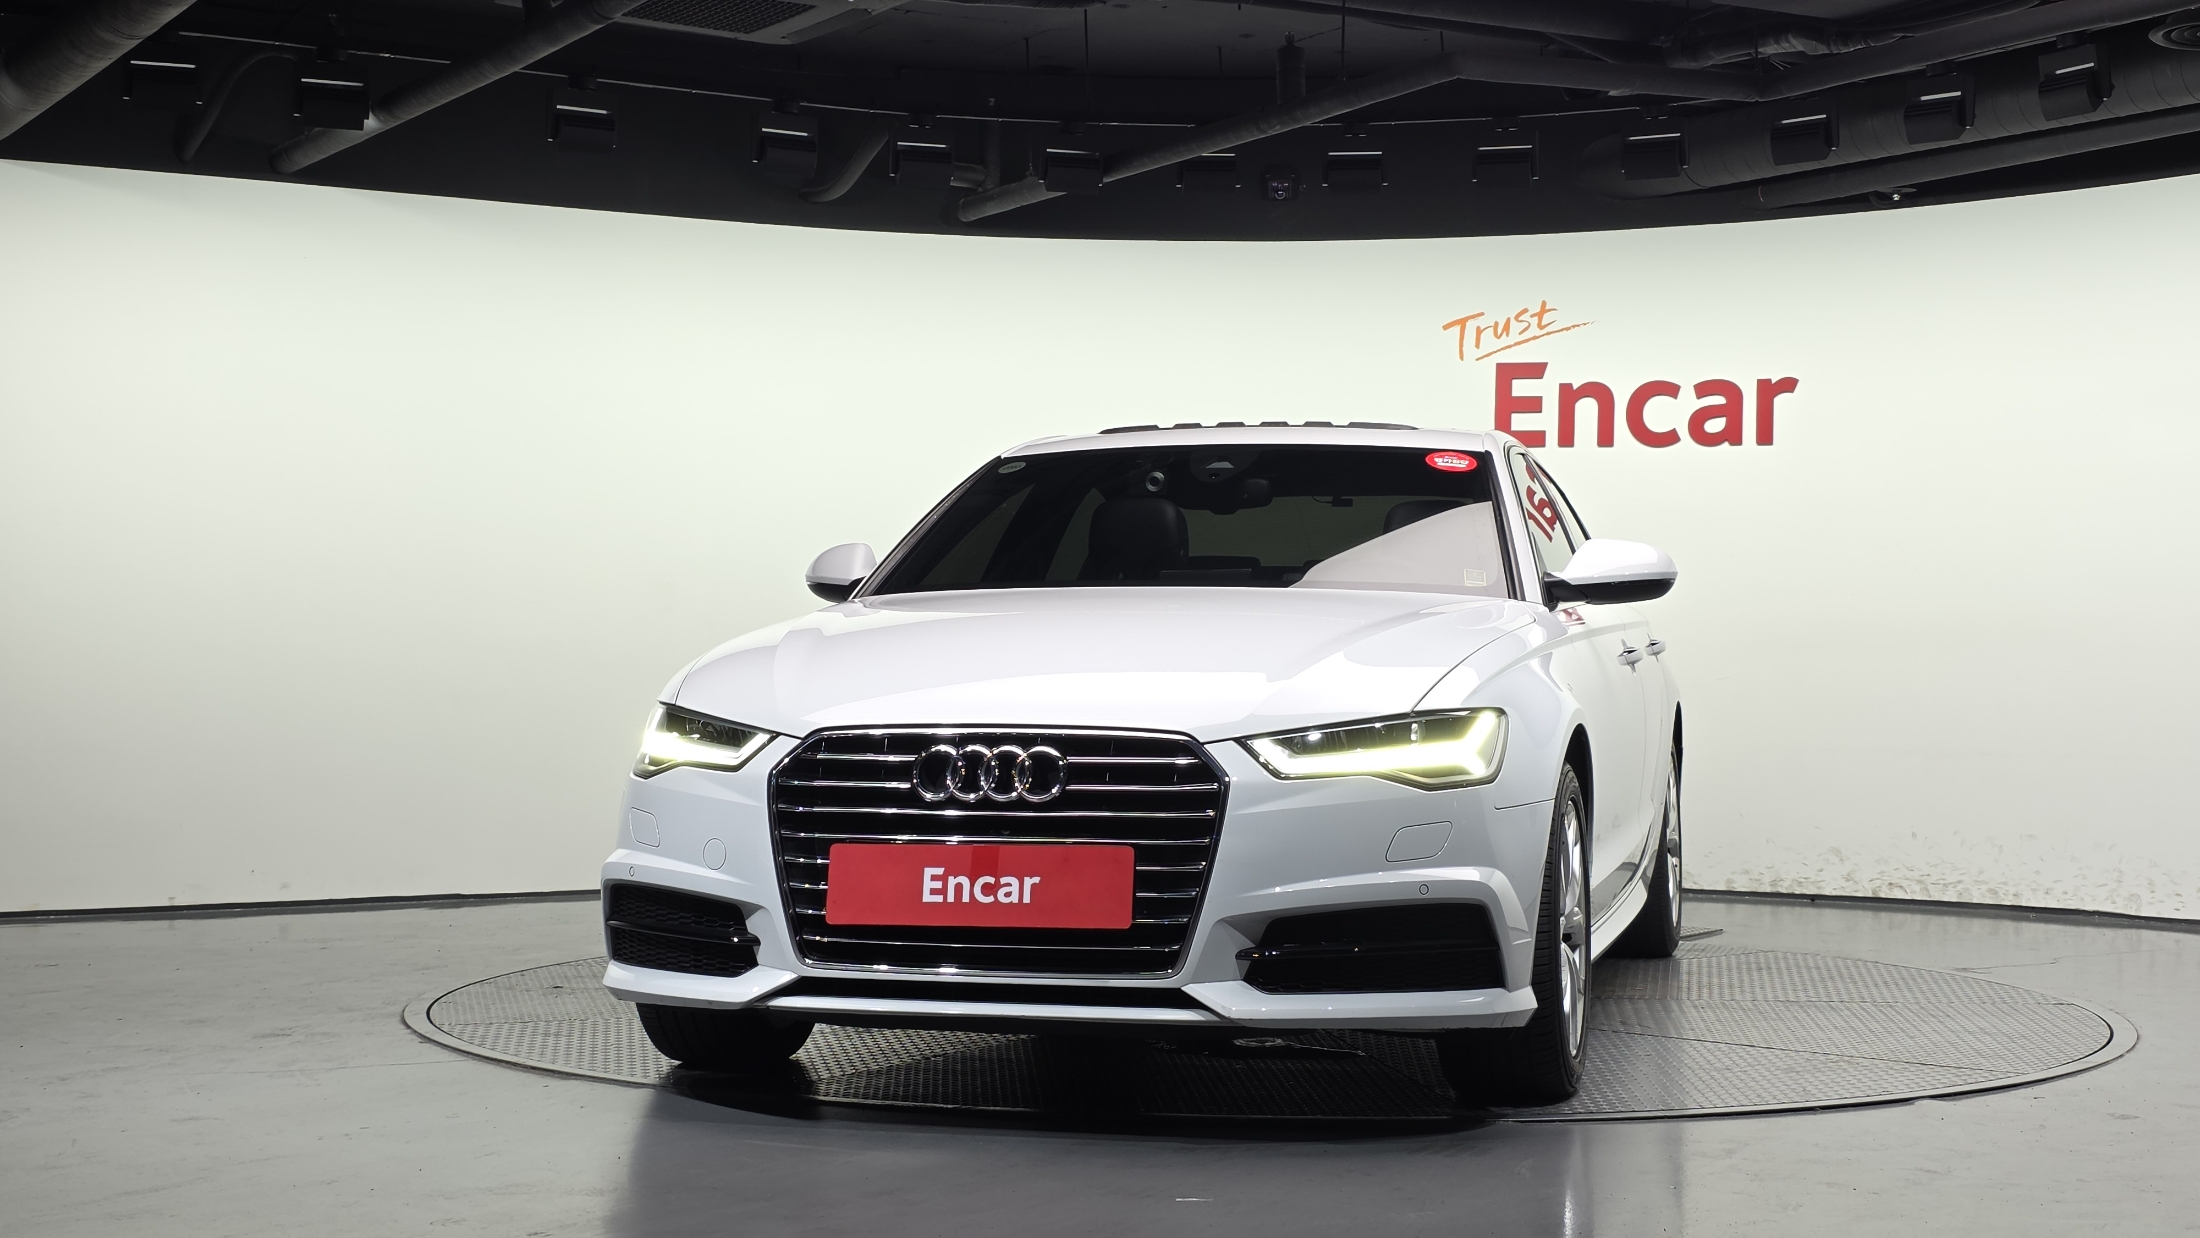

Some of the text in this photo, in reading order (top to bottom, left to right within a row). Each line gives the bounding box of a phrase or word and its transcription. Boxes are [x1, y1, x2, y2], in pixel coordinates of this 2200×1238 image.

[1442, 300, 1559, 361] Trust
[1495, 362, 1799, 448] Encar
[922, 867, 1041, 904] Encar
